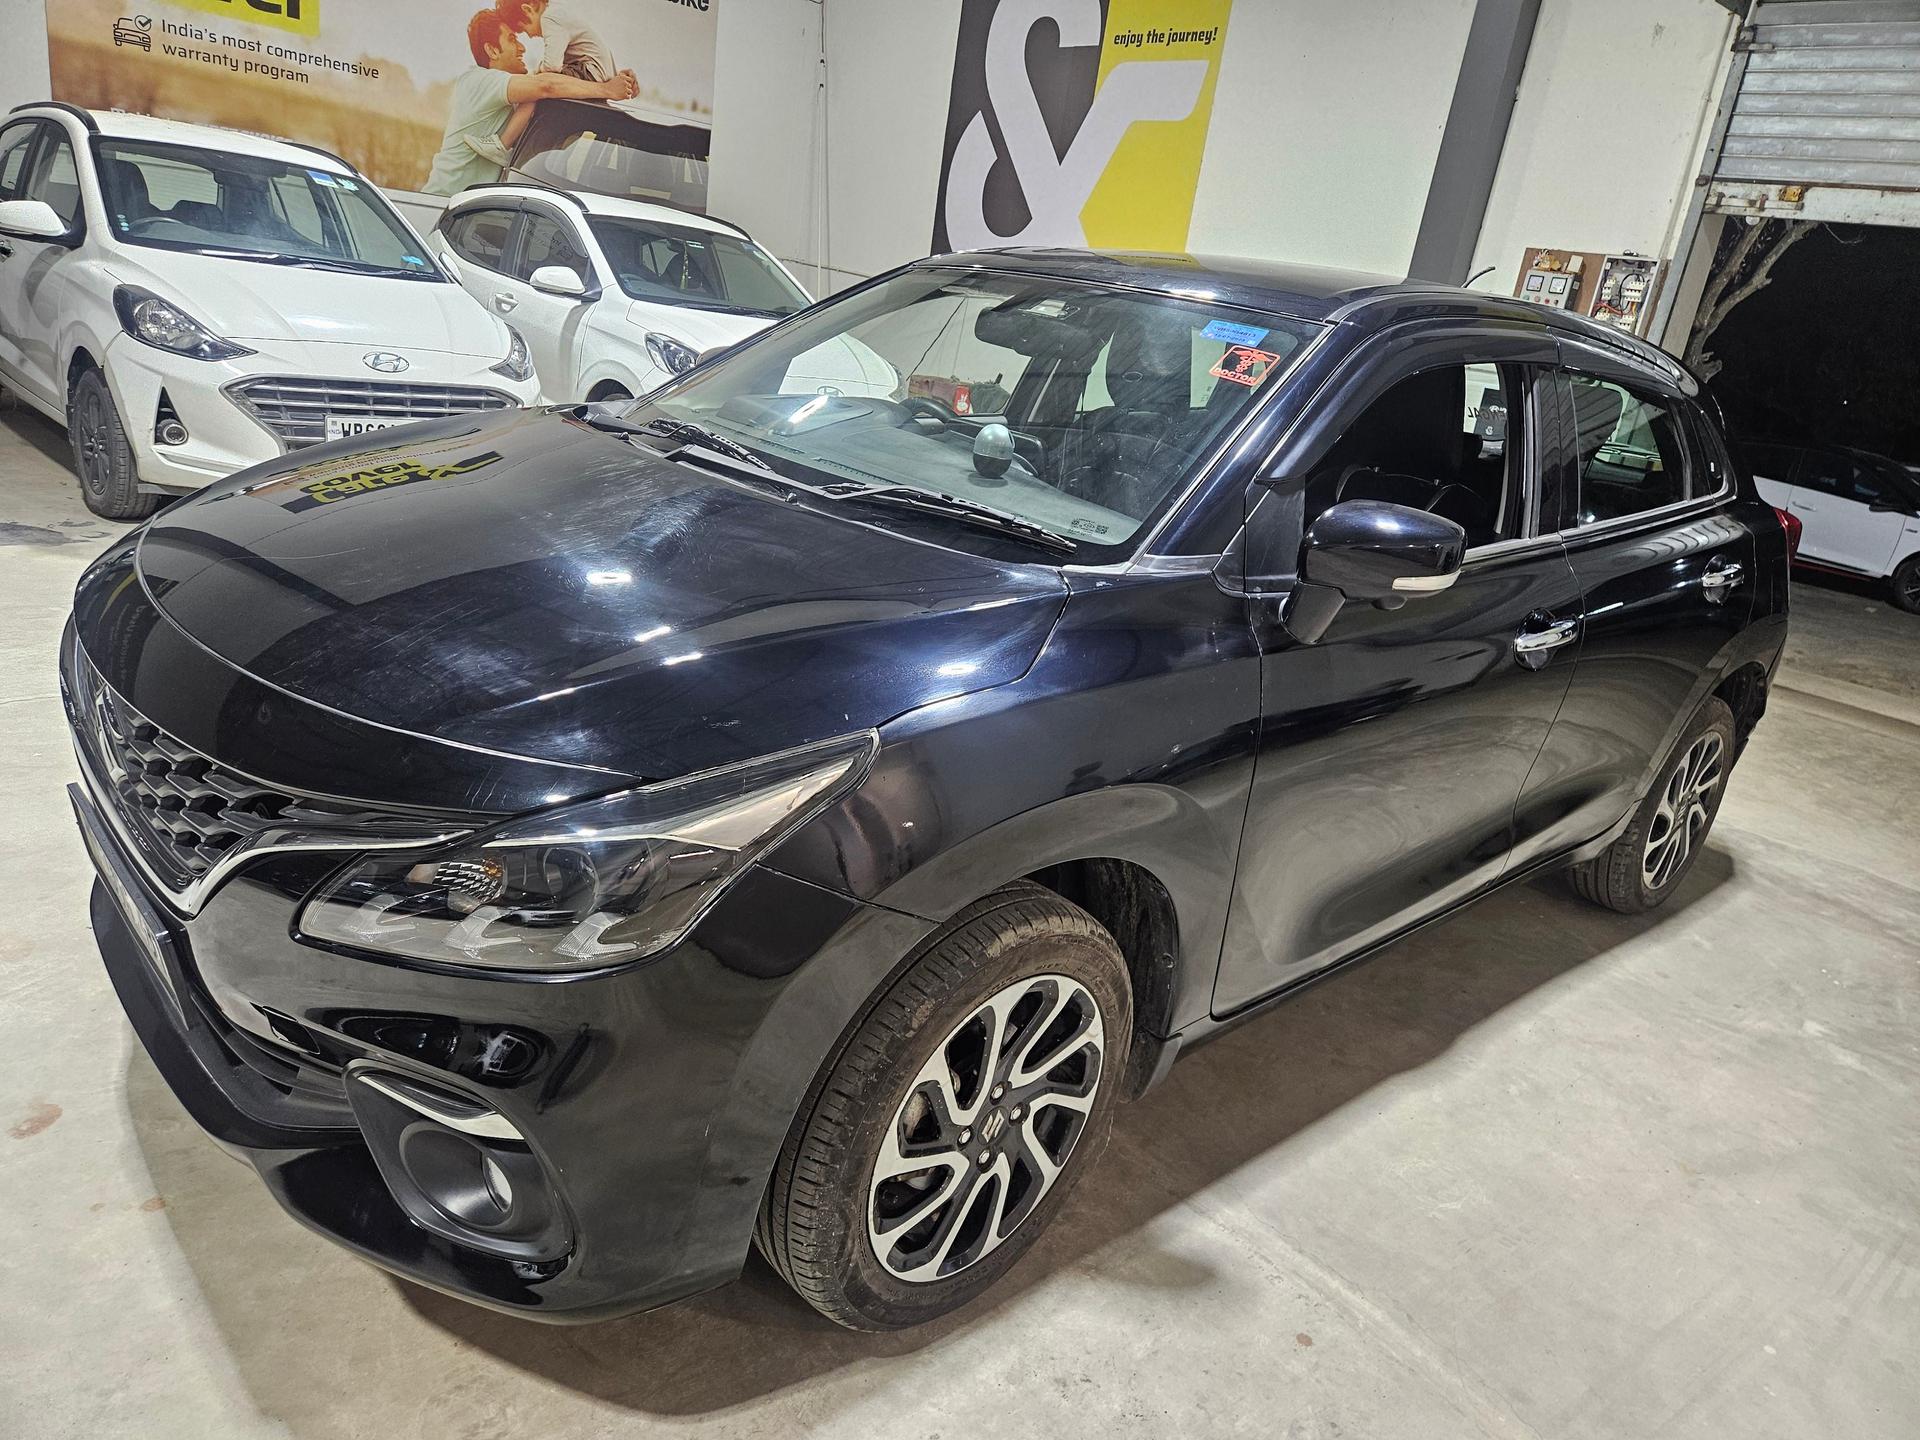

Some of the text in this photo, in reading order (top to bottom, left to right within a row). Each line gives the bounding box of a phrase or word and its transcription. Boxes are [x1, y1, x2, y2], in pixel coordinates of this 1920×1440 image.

[1114, 27, 1218, 47] enjoy the journey!
[162, 43, 309, 83] warranty program
[222, 35, 262, 52] most
[266, 45, 379, 79] comprehensive
[1213, 367, 1257, 385] DOCTOR
